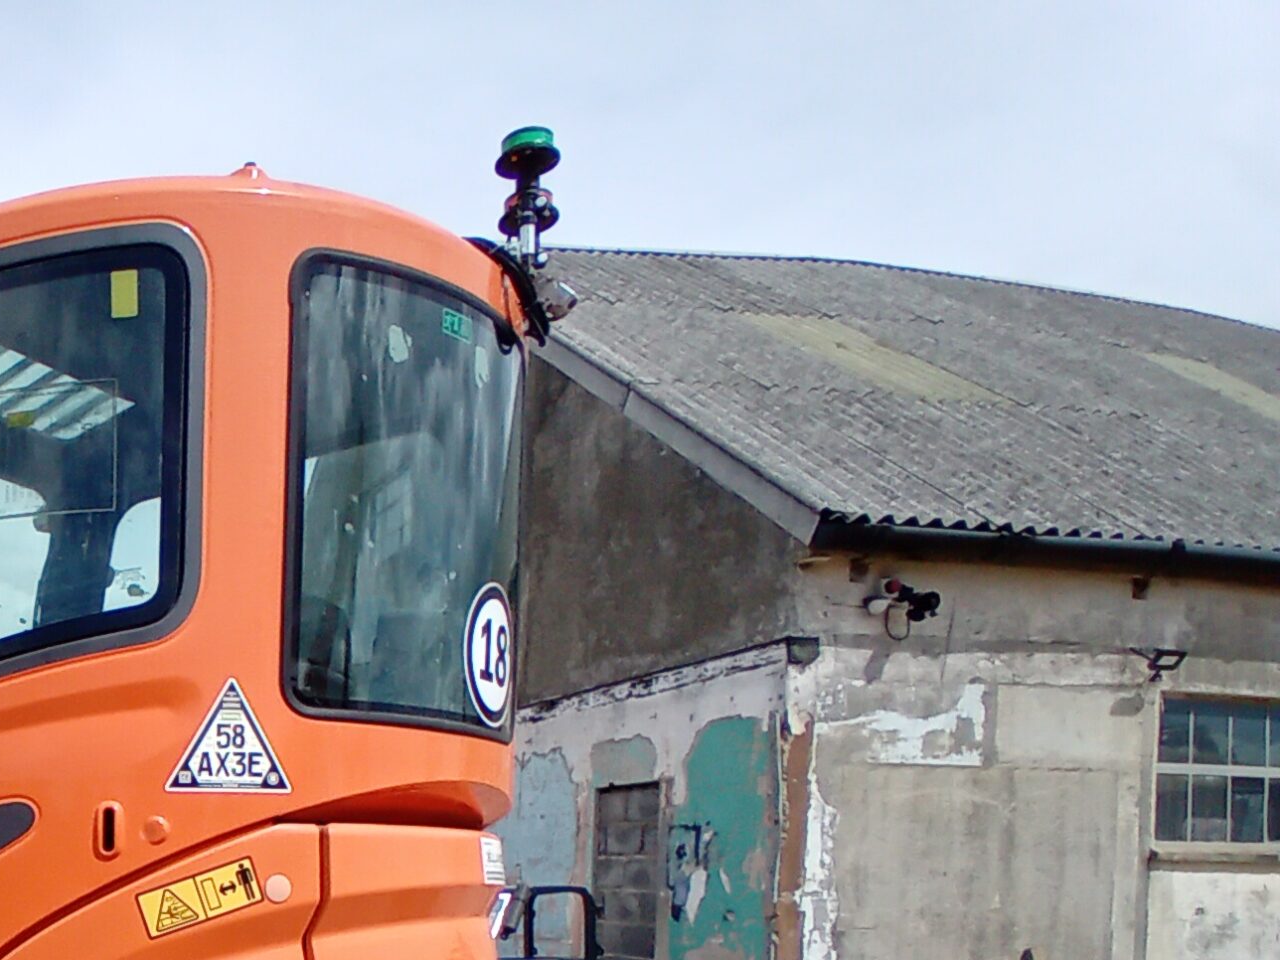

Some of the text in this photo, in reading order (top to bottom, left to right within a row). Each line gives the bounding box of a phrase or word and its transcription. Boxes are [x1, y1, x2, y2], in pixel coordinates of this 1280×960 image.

[480, 618, 507, 688] 18
[216, 723, 245, 749] 58
[197, 751, 263, 777] AX3E
